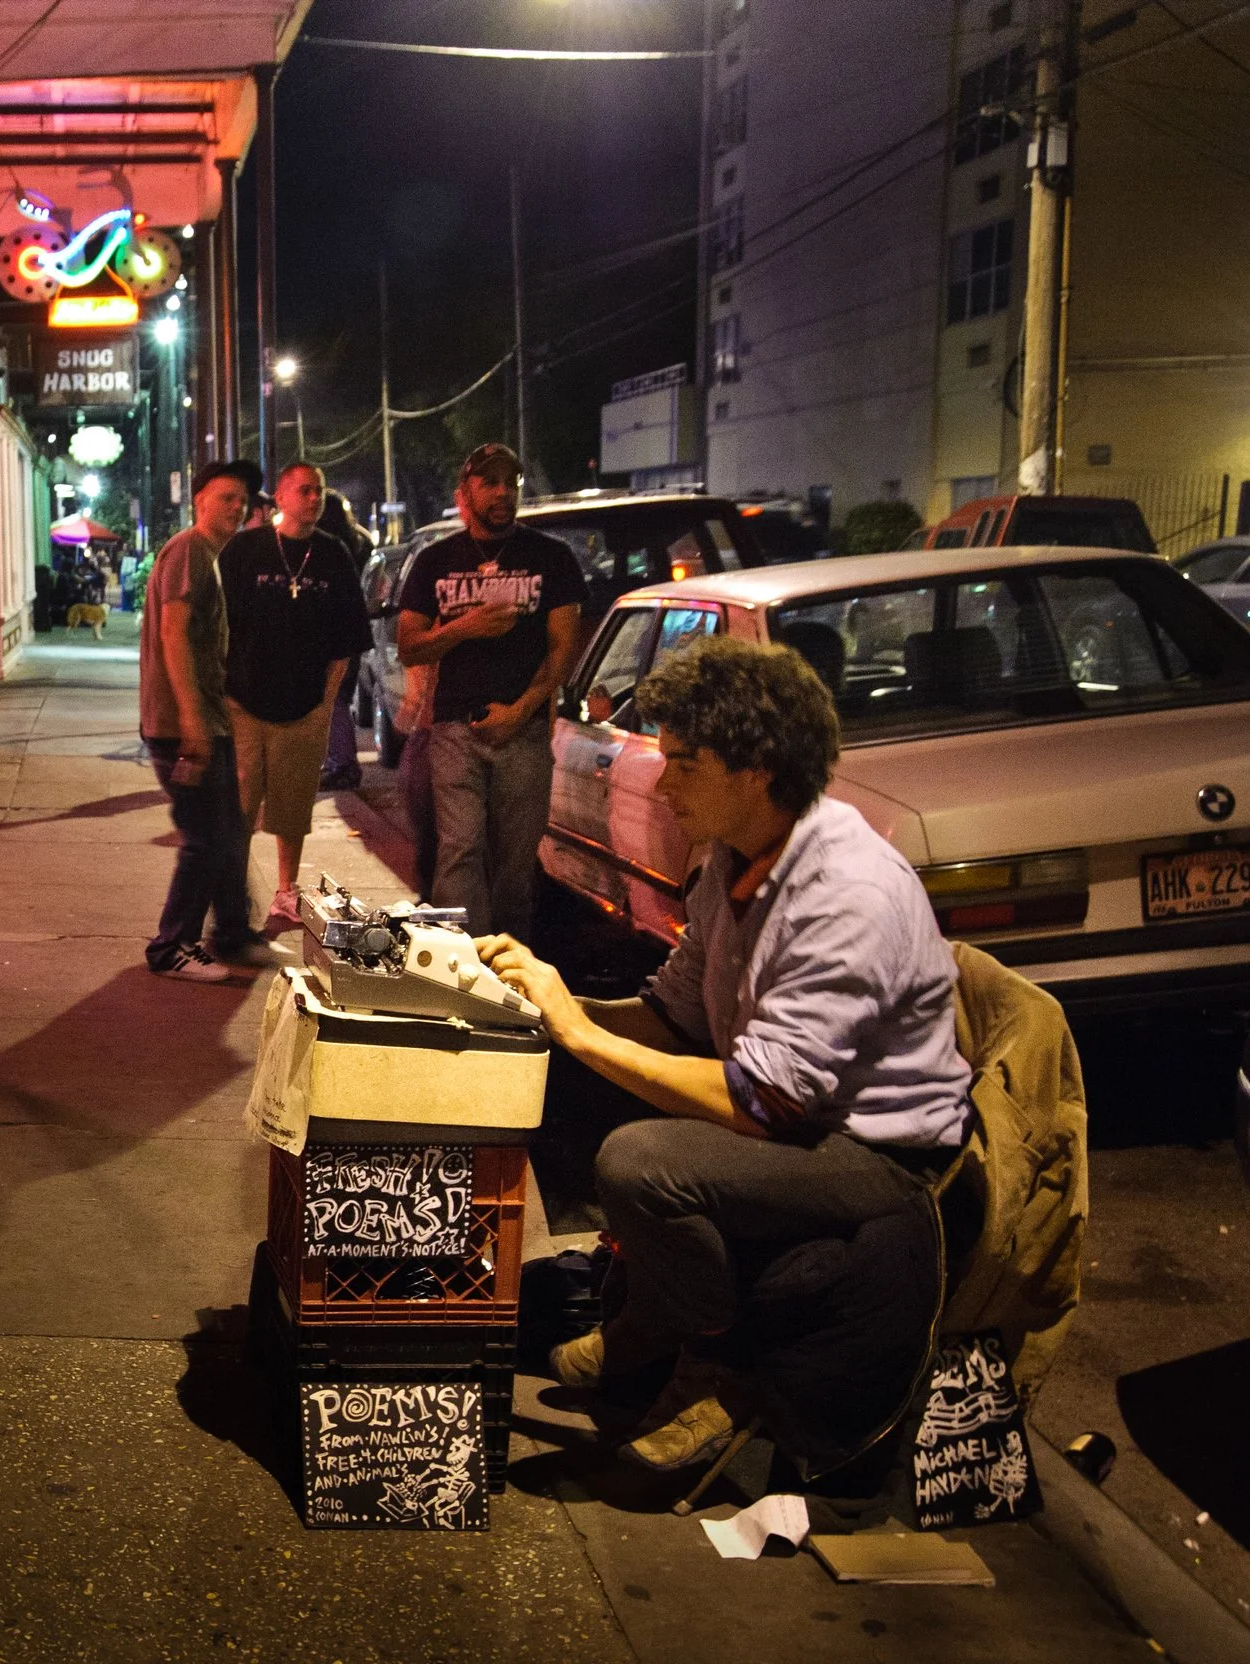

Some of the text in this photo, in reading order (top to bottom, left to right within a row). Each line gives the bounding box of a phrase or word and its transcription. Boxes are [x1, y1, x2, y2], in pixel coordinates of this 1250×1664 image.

[58, 349, 114, 369] SNUG
[43, 371, 131, 393] HARBOR
[1151, 867, 1191, 902] AHK
[1186, 898, 1230, 911] FULTON
[310, 1385, 477, 1434] POEM'S!
[916, 1464, 990, 1506] HAYDEN
[315, 1496, 343, 1510] 2010
[315, 1511, 349, 1523] CONAN
